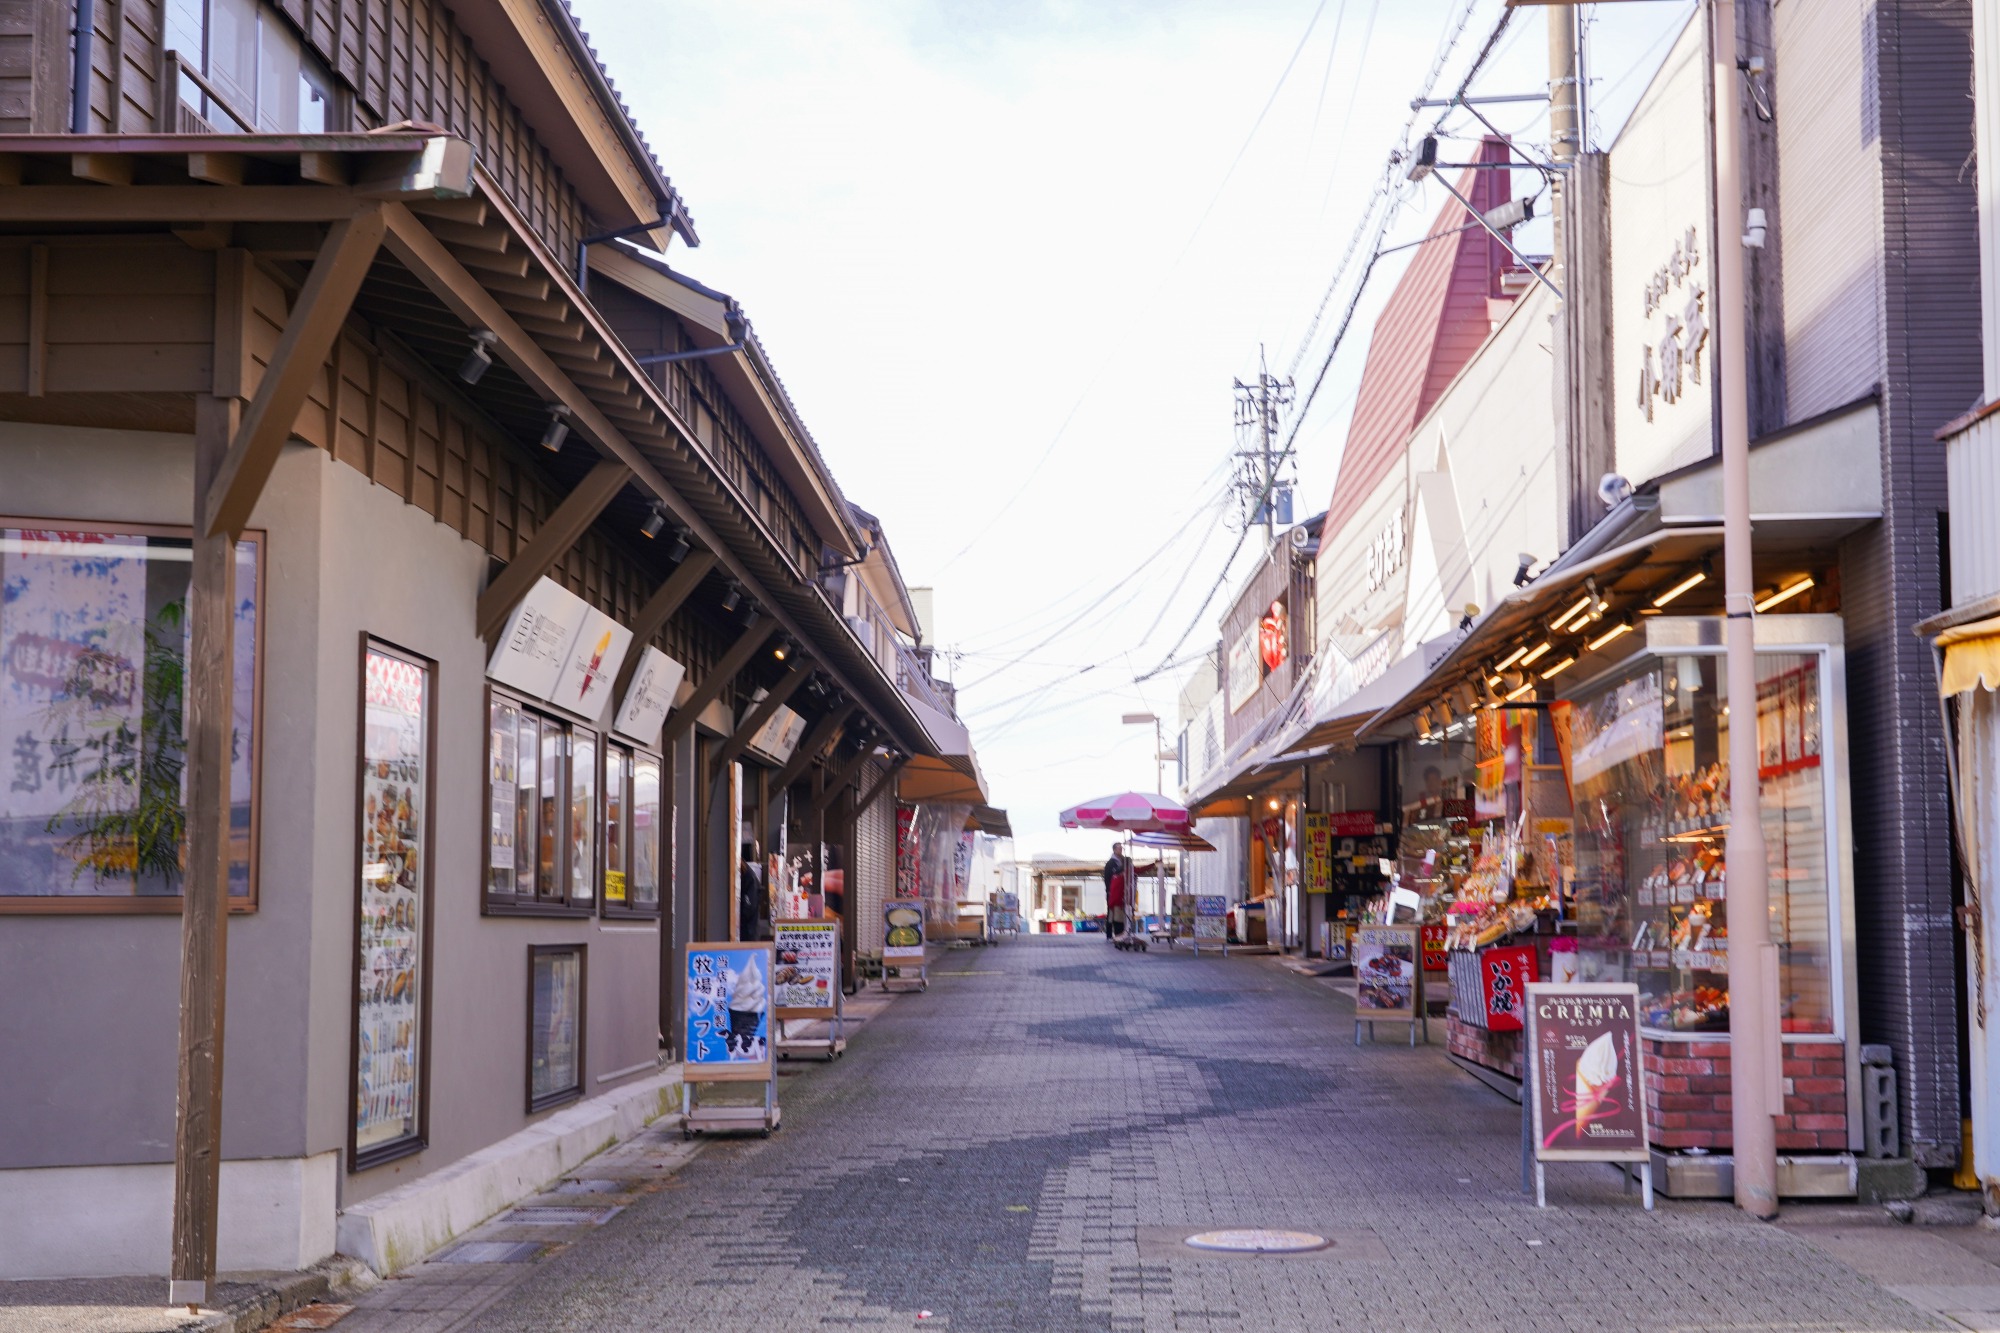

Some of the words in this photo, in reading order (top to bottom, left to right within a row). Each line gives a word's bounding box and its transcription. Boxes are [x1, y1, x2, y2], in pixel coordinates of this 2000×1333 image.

[1313, 830, 1326, 887] 地ビール
[693, 955, 713, 1060] 牧場ソフト
[713, 955, 728, 1030] 当店自家製
[1489, 959, 1513, 1016] いか焼
[1539, 1004, 1630, 1019] CREMIA
